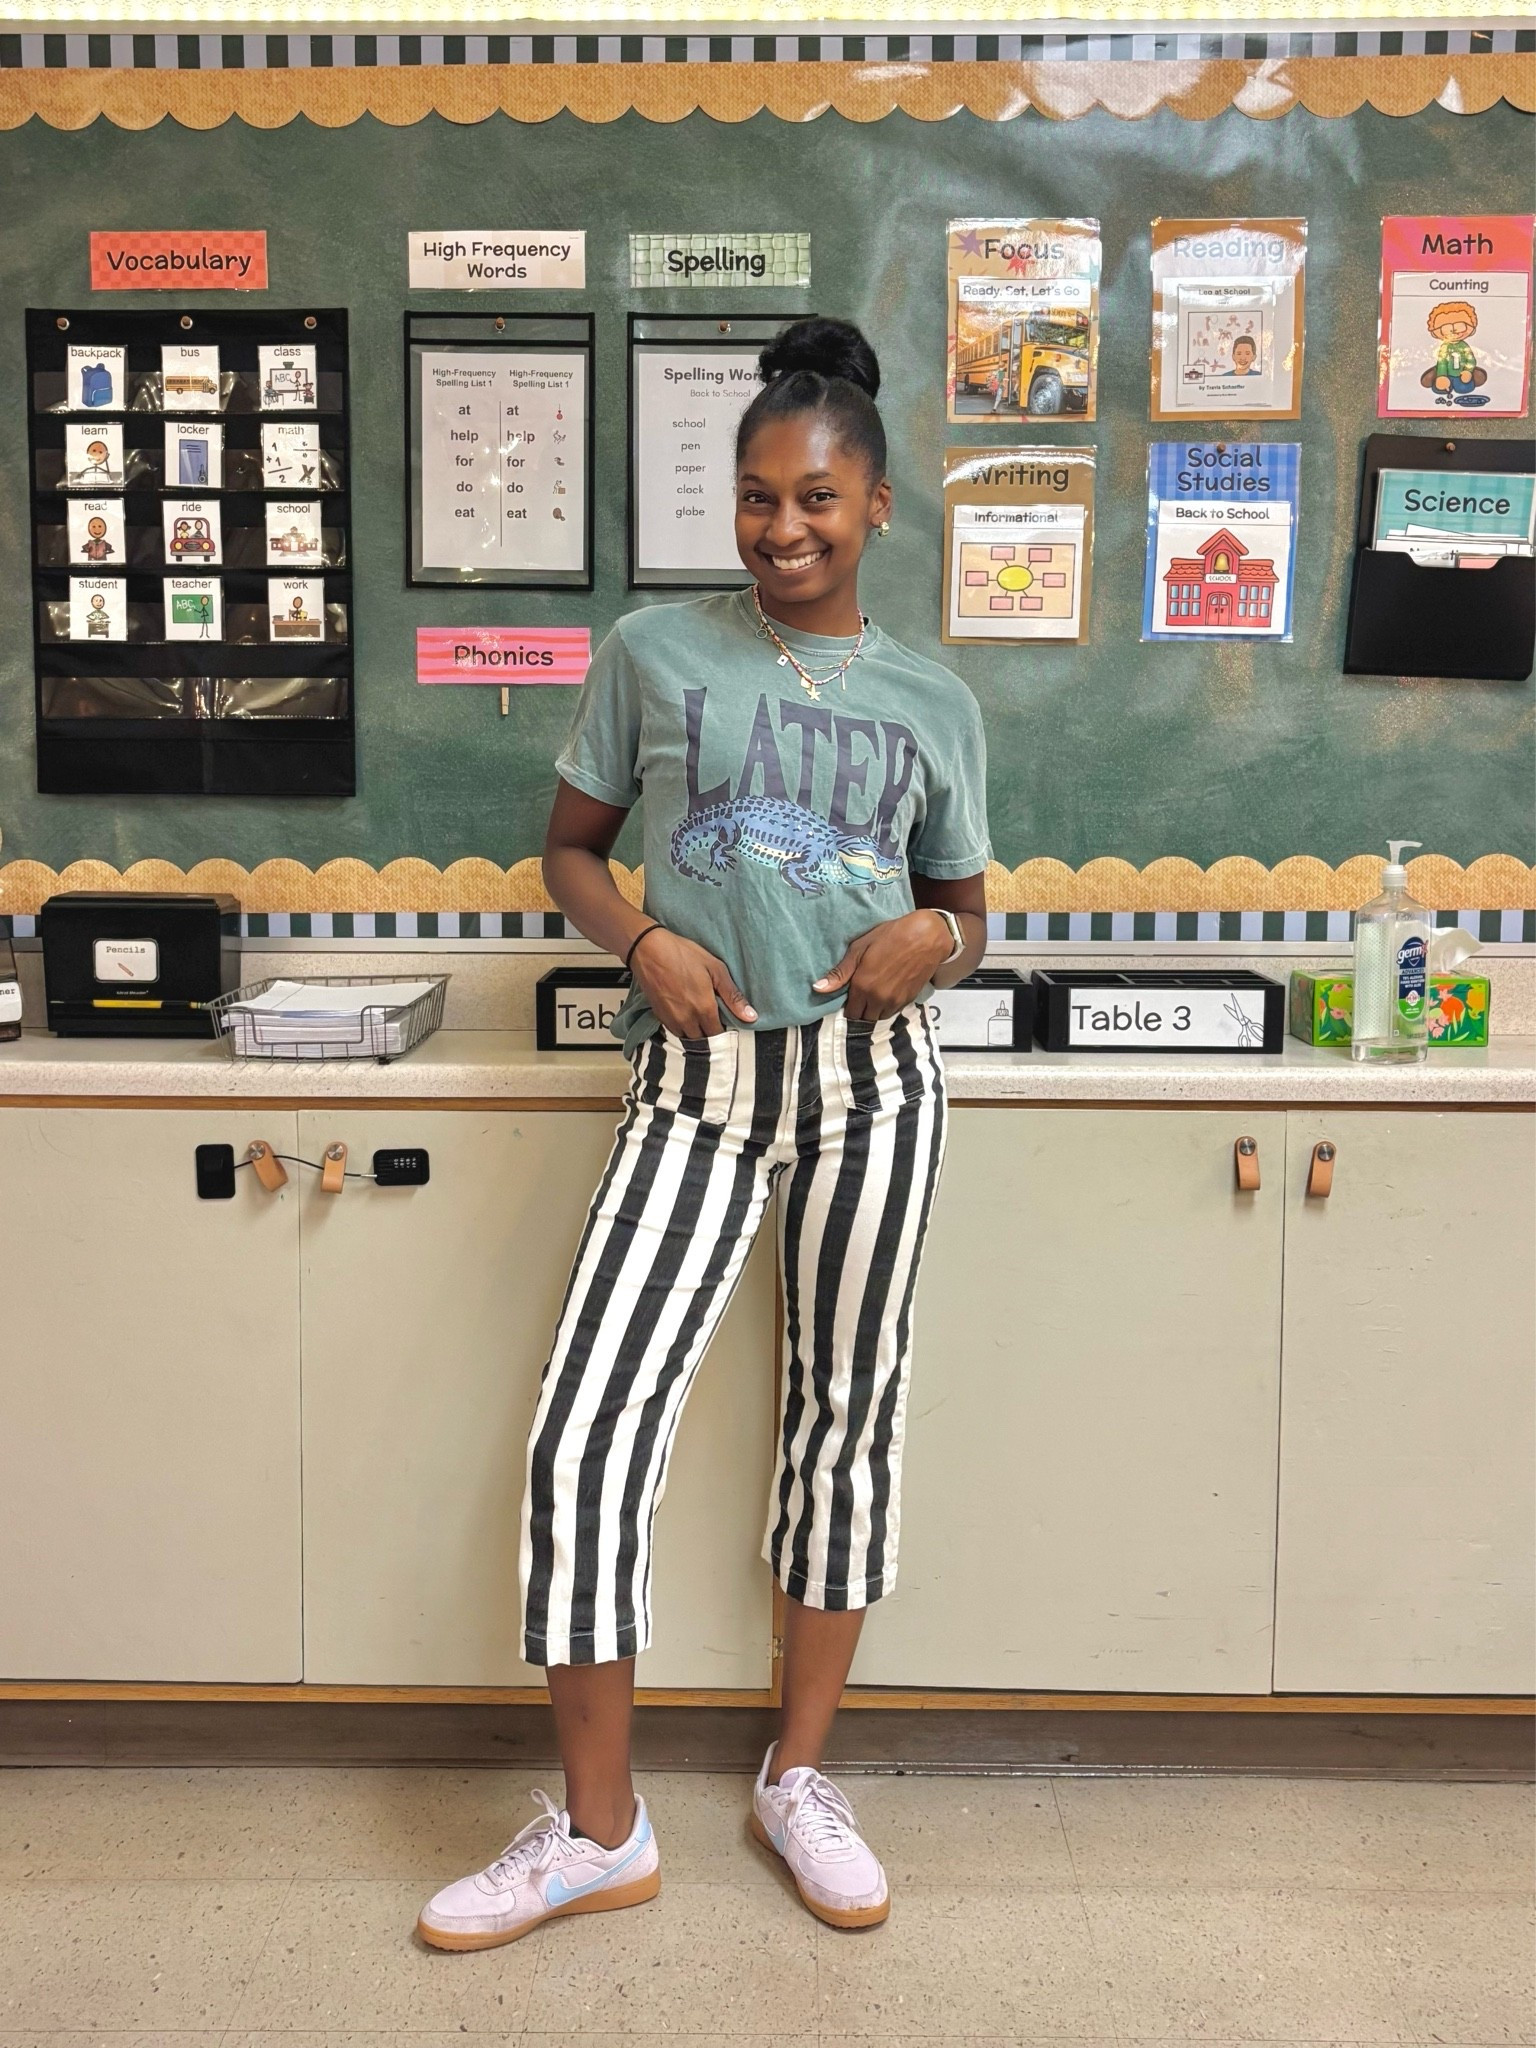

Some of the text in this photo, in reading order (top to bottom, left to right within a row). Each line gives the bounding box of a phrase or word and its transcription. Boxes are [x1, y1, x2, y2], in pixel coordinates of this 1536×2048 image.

[983, 238, 1066, 260] Focus
[1421, 233, 1494, 255] Math
[423, 241, 571, 261] High Frequency
[1174, 237, 1285, 264] Reading
[106, 247, 252, 277] Vocabulary
[667, 247, 766, 278] Spelling
[467, 263, 528, 279] Words
[1031, 285, 1061, 296] Let's
[1064, 285, 1080, 296] Go
[1429, 278, 1489, 293] Counting
[71, 347, 122, 360] backpack
[180, 347, 200, 358] bus
[273, 347, 302, 357] class
[274, 373, 291, 384] ABC
[432, 368, 496, 378] High-Frequency
[509, 369, 573, 379] High-Frequency
[664, 368, 760, 385] Spelling Wor
[436, 379, 493, 388] Spelling List 1
[512, 380, 570, 389] Spelling List 1
[690, 389, 751, 398] Back to School
[458, 404, 472, 415] at
[506, 405, 520, 416] at
[672, 417, 706, 428] school
[81, 425, 108, 436] learn
[177, 425, 210, 435] locker
[278, 426, 305, 435] math
[450, 429, 479, 443] help
[506, 430, 536, 443] help
[271, 441, 278, 451] 1
[681, 442, 701, 452] pen
[275, 456, 281, 467] 1
[455, 455, 475, 467] for
[506, 456, 526, 468] for
[1187, 447, 1262, 469] Social
[675, 464, 706, 474] paper
[278, 474, 287, 483] 2
[970, 464, 1070, 491] Writing
[1177, 471, 1271, 493] Studies
[456, 481, 474, 493] do
[506, 482, 524, 494] do
[676, 484, 704, 494] clock
[84, 501, 108, 512] read
[181, 502, 202, 512] ride
[1404, 488, 1511, 515] Science
[276, 503, 311, 514] school
[454, 507, 476, 518] eat
[506, 508, 528, 519] eat
[675, 507, 705, 518] globe
[1175, 507, 1270, 520] Back to School
[974, 510, 1059, 524] Informational
[78, 580, 119, 590] student
[171, 579, 213, 590] teacher
[283, 580, 309, 590] work
[176, 599, 195, 610] ABC
[454, 645, 554, 666] Phonics
[682, 686, 919, 859] LATER
[106, 946, 146, 954] Pencils
[557, 1000, 625, 1030] Tab
[929, 1005, 942, 1031] 2
[1071, 1001, 1192, 1032] Table 3
